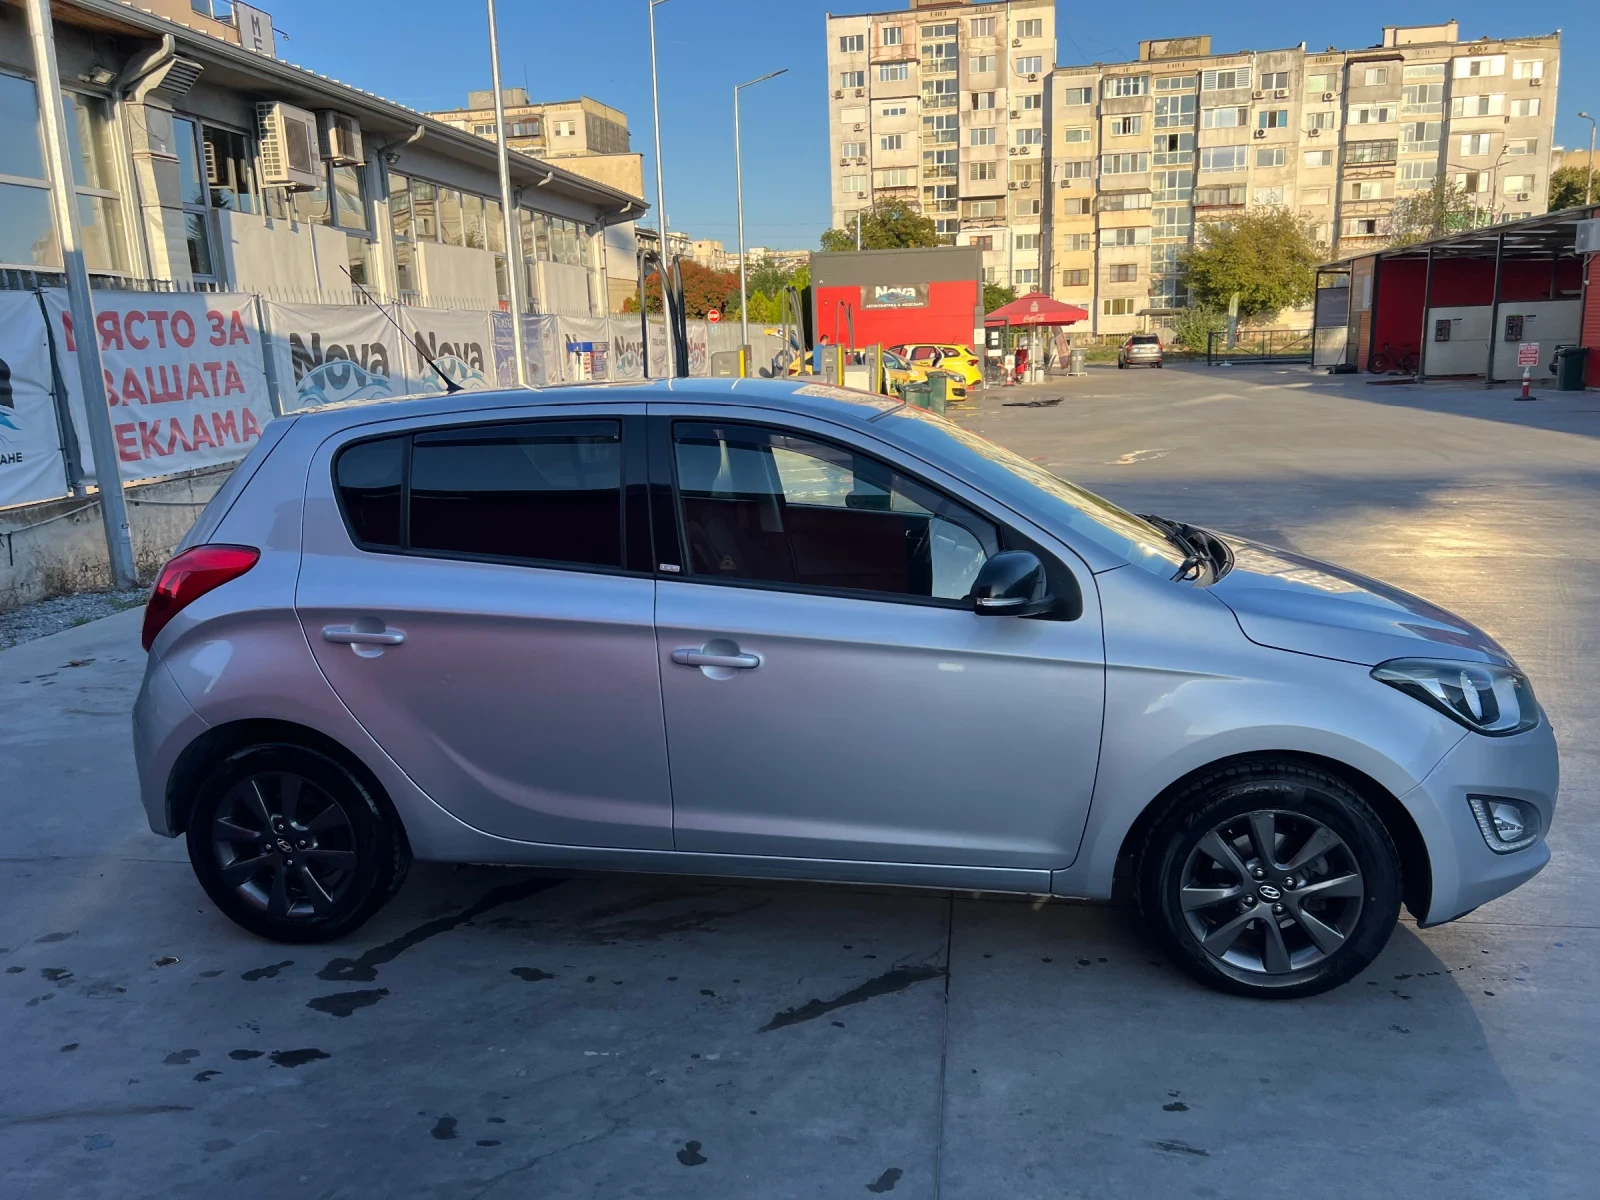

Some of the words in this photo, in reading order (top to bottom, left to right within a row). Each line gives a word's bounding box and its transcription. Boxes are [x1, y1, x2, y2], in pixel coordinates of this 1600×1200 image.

[875, 285, 916, 299] Nova
[206, 310, 251, 346] ЗА
[290, 332, 391, 393] Nova
[414, 331, 485, 386] Nova
[114, 407, 263, 463] ЕКЛАМА
[0, 452, 23, 465] АНЕ
